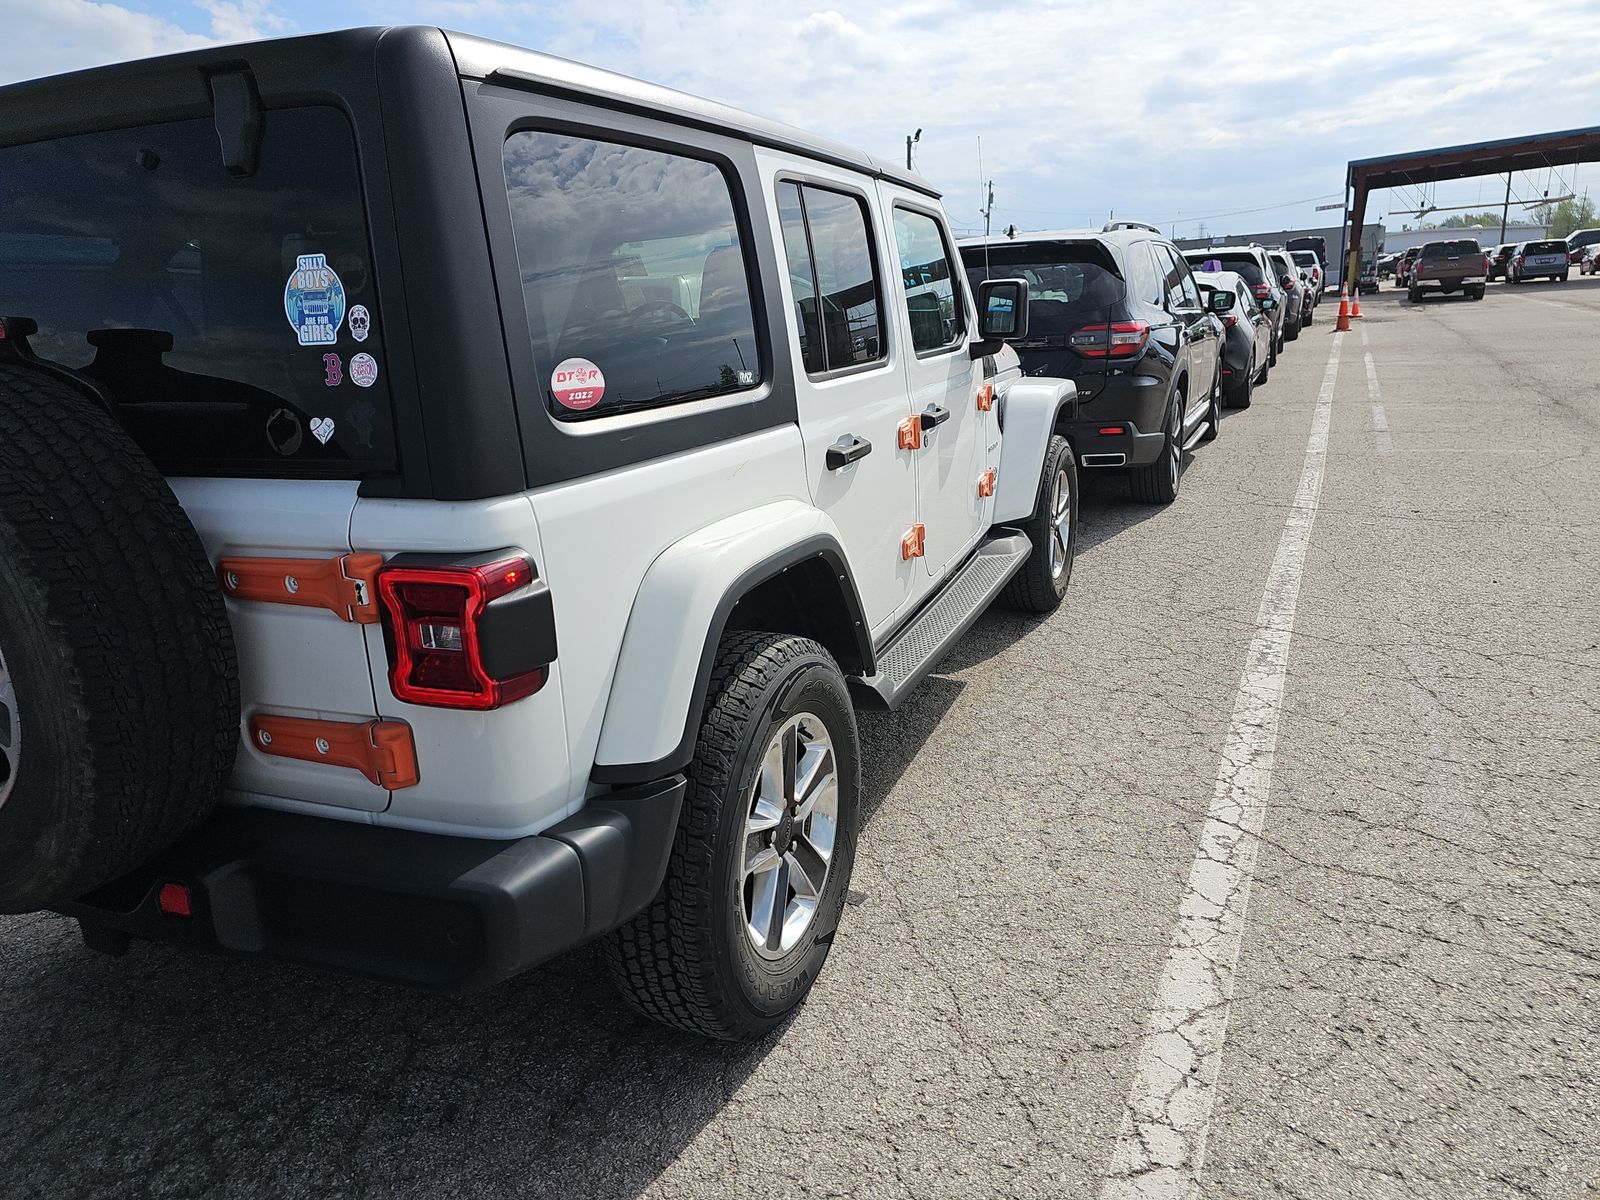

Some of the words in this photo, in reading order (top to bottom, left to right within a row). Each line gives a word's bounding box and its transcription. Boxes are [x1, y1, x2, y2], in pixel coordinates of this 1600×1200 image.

[300, 257, 323, 271] SILLY
[297, 270, 329, 289] BOYS
[305, 317, 317, 325] ARE
[317, 316, 329, 324] FOR
[300, 324, 335, 342] GIRLS
[568, 391, 594, 401] 2022
